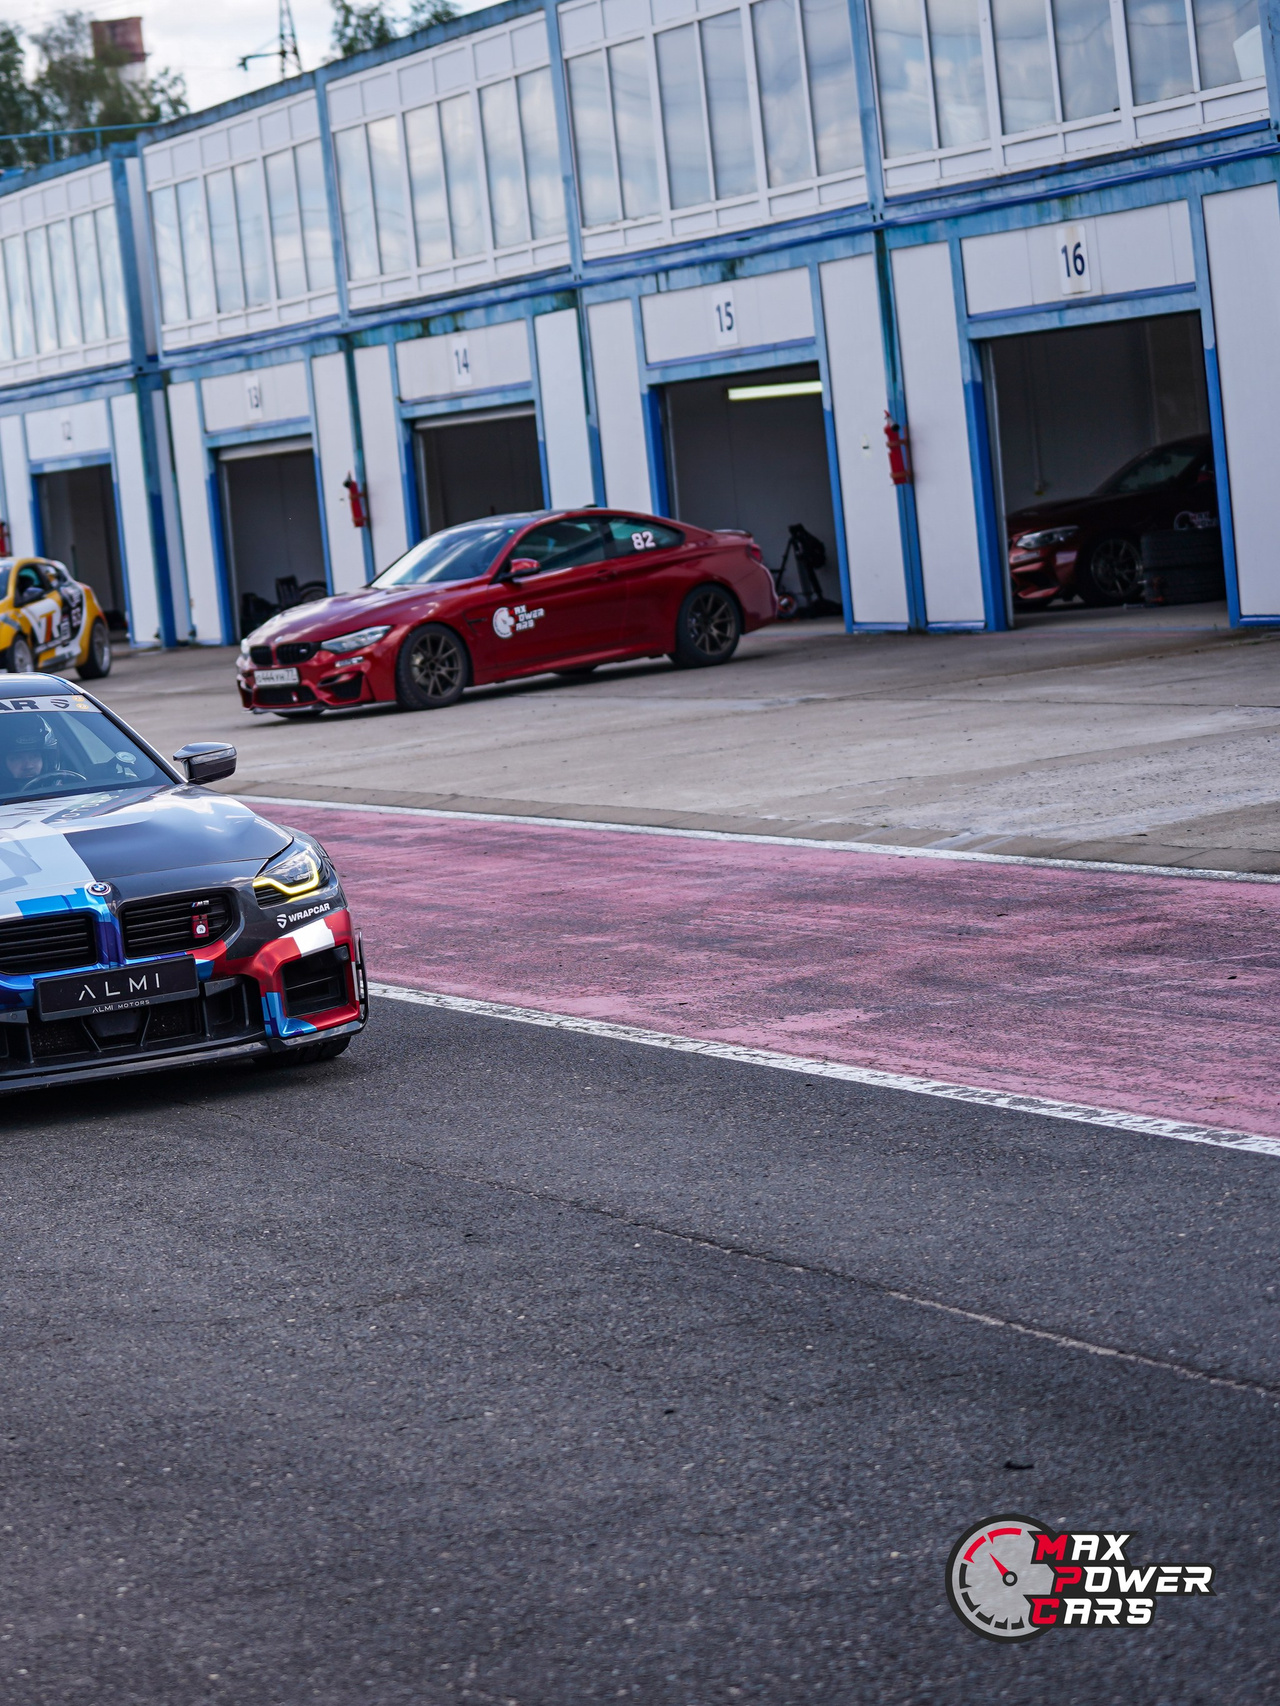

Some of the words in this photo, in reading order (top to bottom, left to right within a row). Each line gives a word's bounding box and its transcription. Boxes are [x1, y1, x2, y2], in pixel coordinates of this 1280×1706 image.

[1060, 241, 1086, 278] 16
[715, 301, 735, 332] 15
[454, 348, 470, 374] 14
[631, 531, 656, 550] 82
[288, 902, 331, 922] WRAPCAR
[78, 973, 160, 1001] ALMI
[92, 1004, 114, 1013] ALMI
[117, 999, 150, 1009] MOTORS
